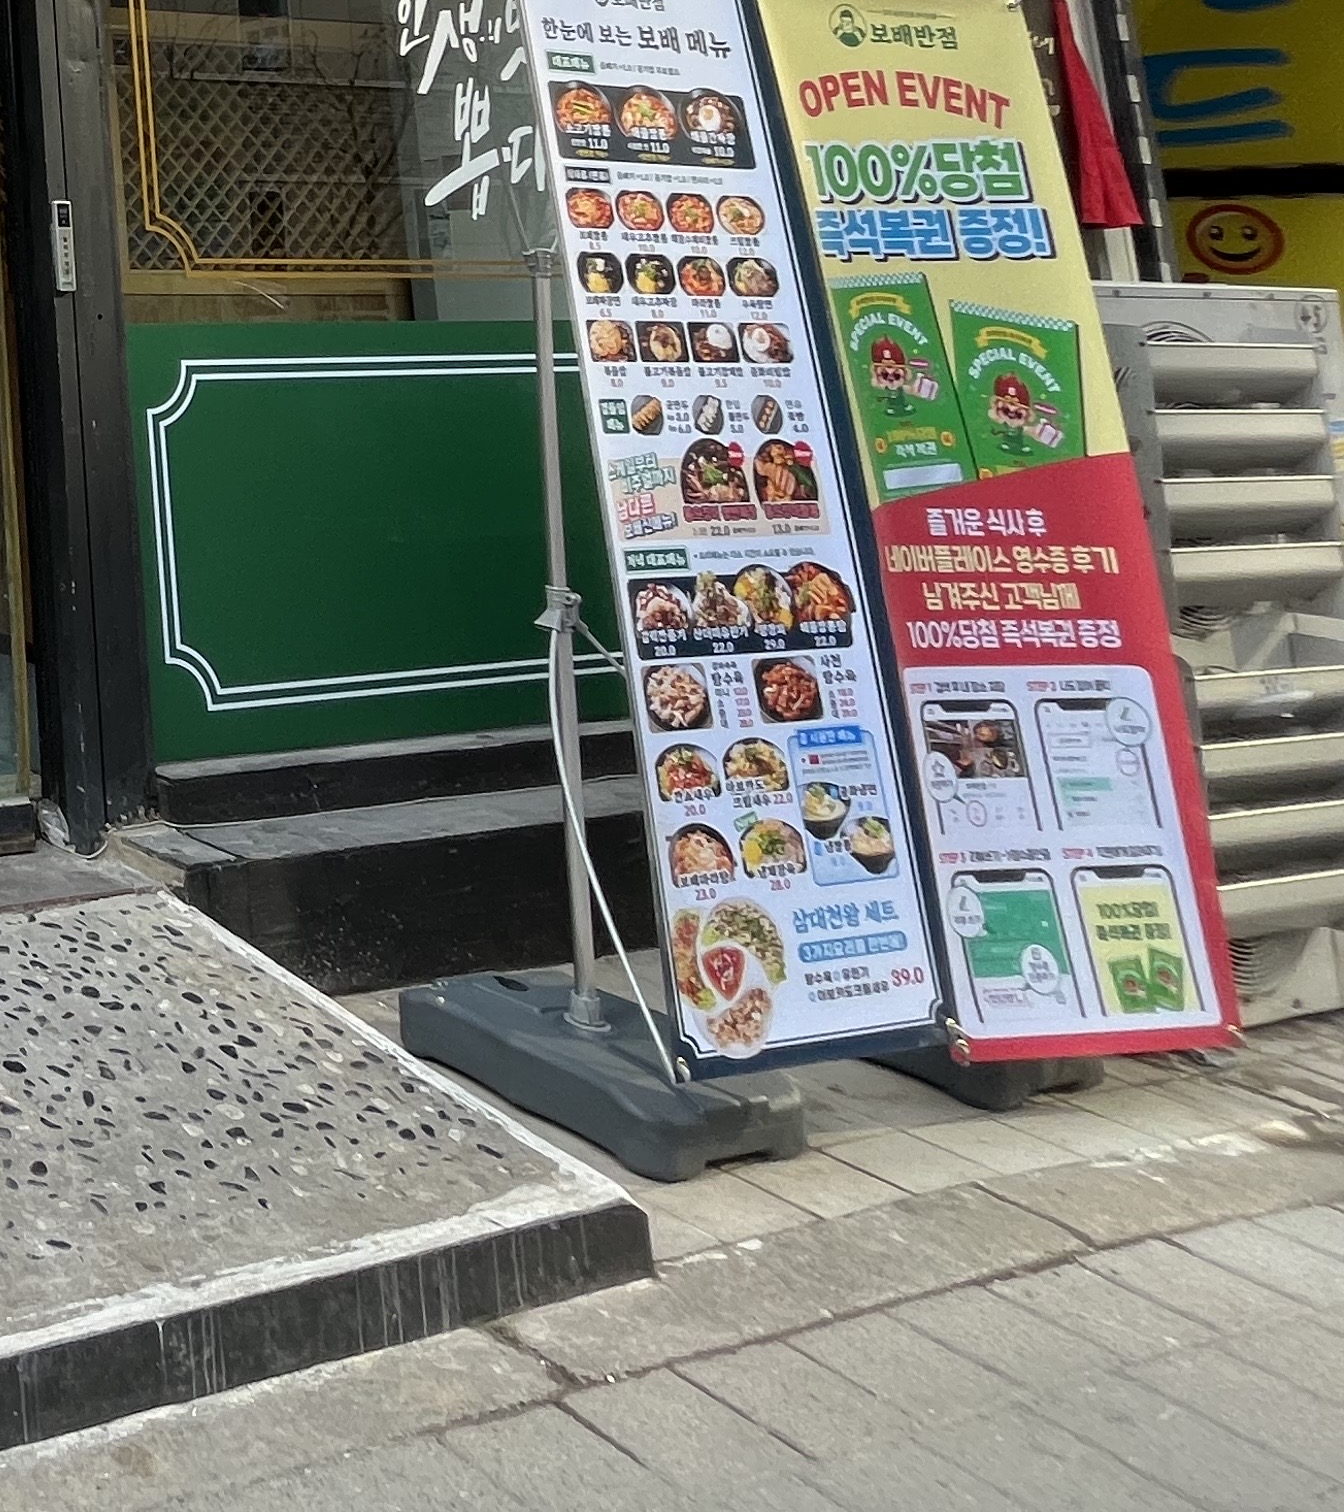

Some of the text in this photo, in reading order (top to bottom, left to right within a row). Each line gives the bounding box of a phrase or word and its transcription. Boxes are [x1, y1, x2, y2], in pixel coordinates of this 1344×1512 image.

[541, 17, 731, 59] 한눈에 보는 보배 메뉴
[870, 24, 958, 50] 보배반점
[798, 70, 890, 118] OPEN
[895, 70, 1011, 130] EVENT
[804, 137, 1033, 204] 100%당첨
[815, 206, 1057, 263] 즉석복권 증정!
[850, 312, 929, 351] SPECIAL EVENT
[968, 348, 1061, 392] SPECIAL EVENT
[926, 508, 1047, 537] 즐거운 식사 후
[885, 545, 1119, 574] 네이버플레이스 영수증 후기
[922, 582, 1001, 610] 남겨주신
[906, 619, 1122, 649] 100%당첨 즉석복권 증정
